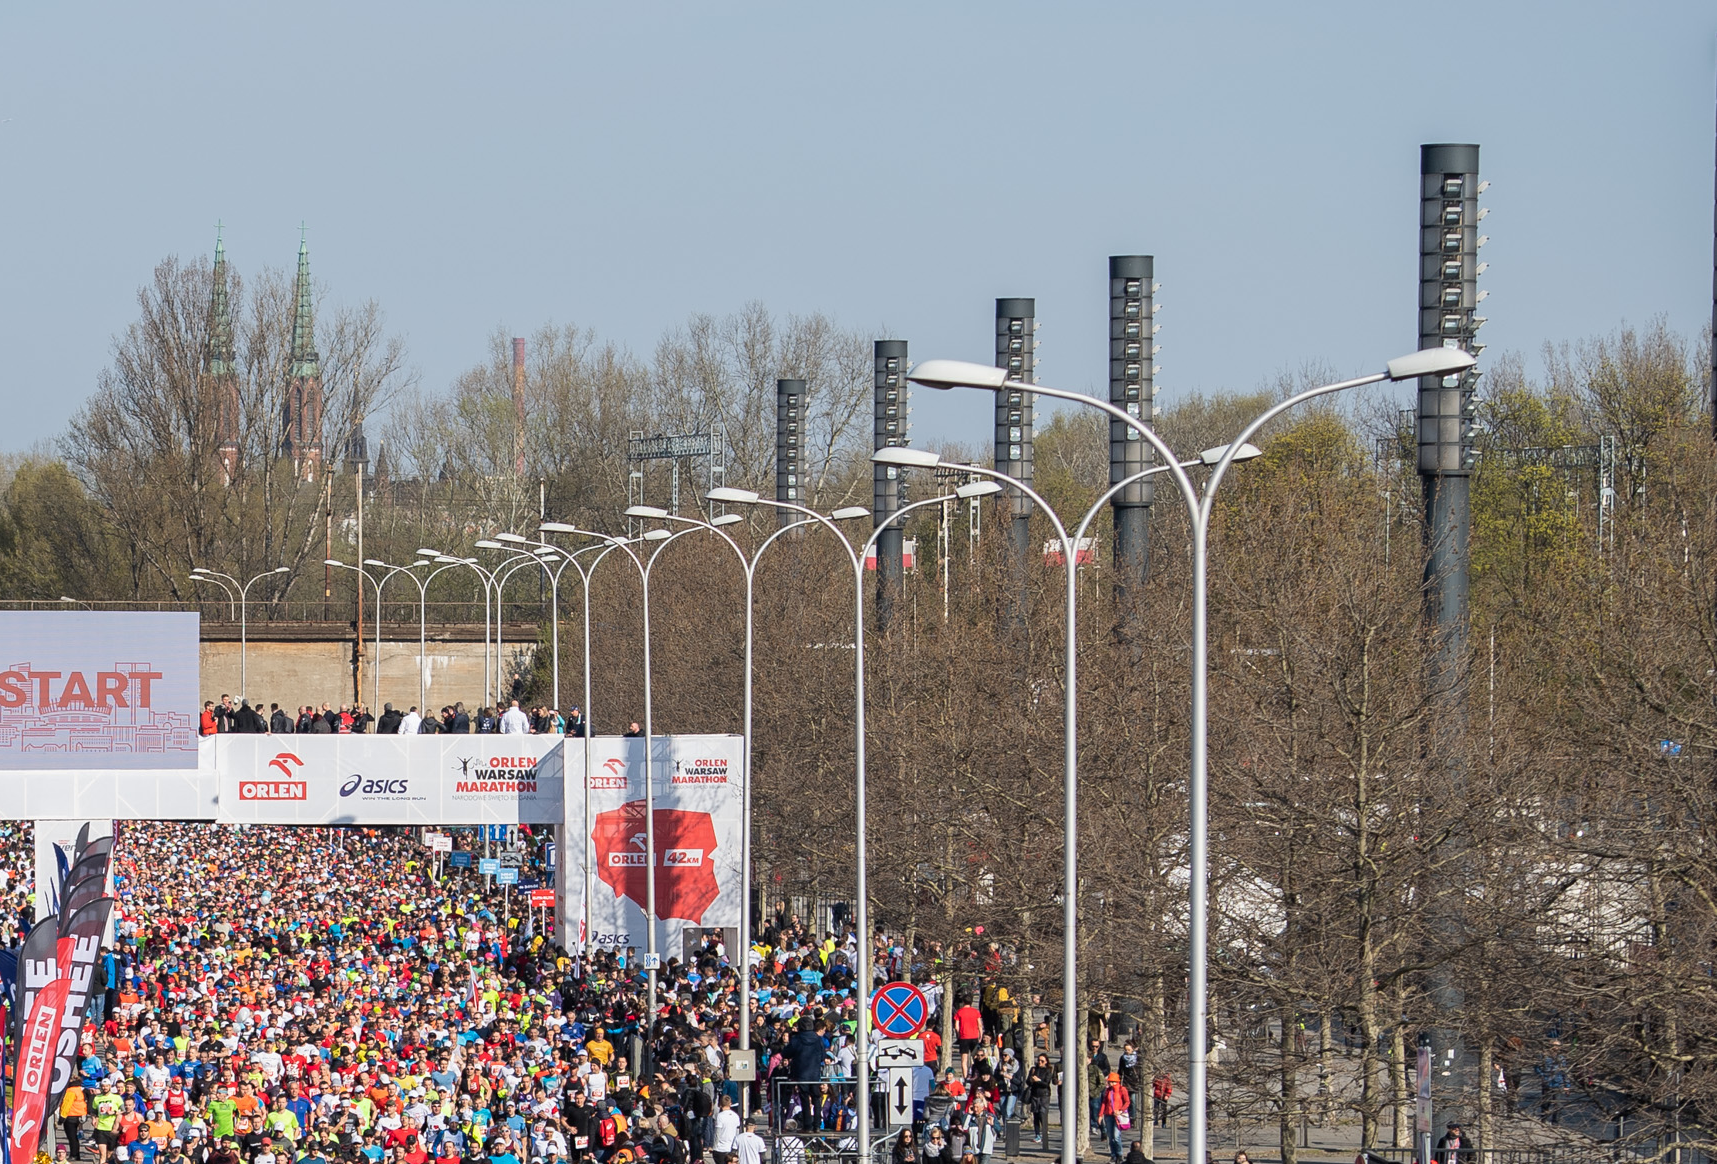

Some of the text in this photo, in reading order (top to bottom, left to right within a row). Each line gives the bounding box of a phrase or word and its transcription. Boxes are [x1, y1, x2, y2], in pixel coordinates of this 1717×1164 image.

[489, 757, 537, 768] ORLEN
[695, 759, 728, 767] ORLEN
[475, 769, 538, 780] WARSAW
[685, 767, 728, 775] WARSAW
[672, 776, 728, 784] MARATHON
[242, 783, 303, 798] ORLEN
[362, 778, 409, 794] asics
[455, 781, 538, 792] MARATHON
[611, 854, 648, 865] ORLE
[27, 1008, 54, 1086] ORLEN
